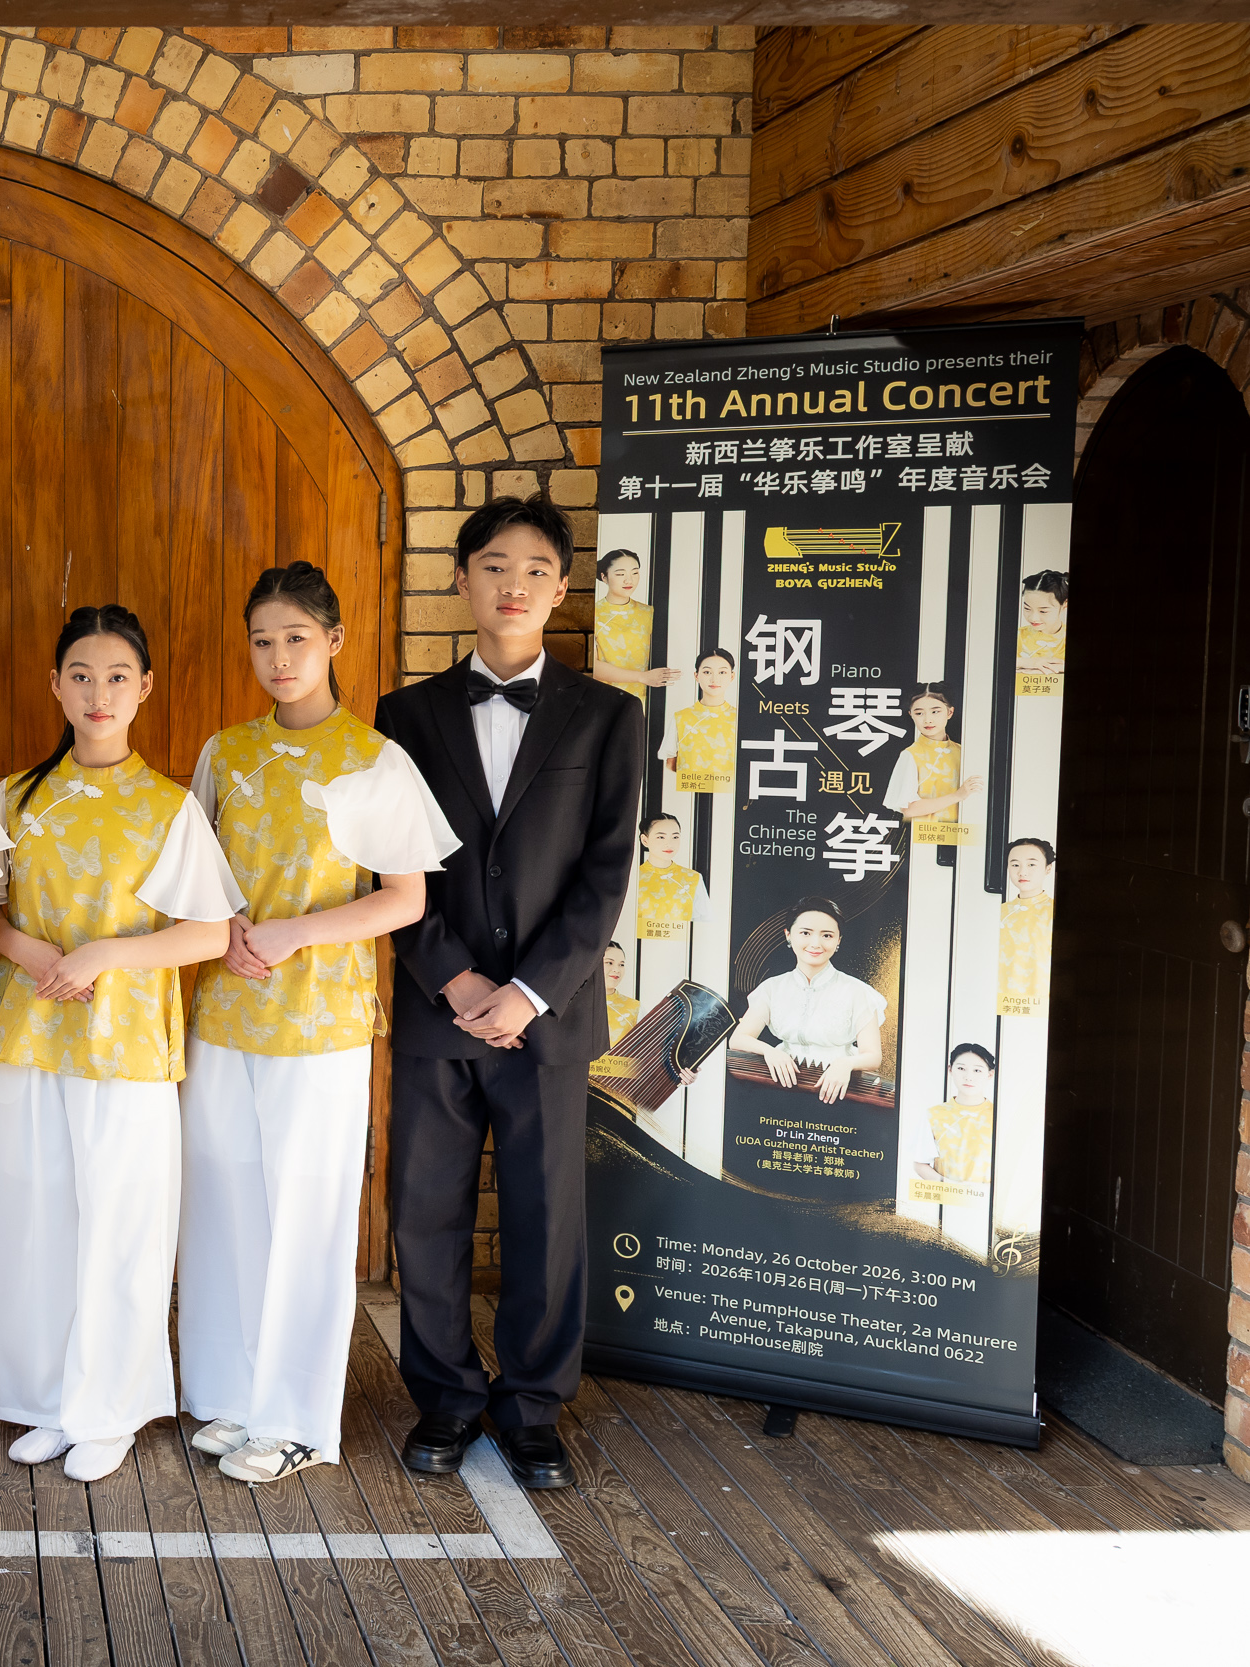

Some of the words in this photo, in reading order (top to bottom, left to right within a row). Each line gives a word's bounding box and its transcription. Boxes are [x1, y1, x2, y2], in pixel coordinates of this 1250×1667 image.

[624, 372, 659, 386] New
[664, 367, 732, 384] Zealand
[810, 359, 858, 377] Music
[863, 356, 920, 374] Studio
[926, 352, 1004, 374] presents
[1009, 349, 1052, 366] their
[625, 390, 706, 422] 11th
[720, 381, 868, 418] Annual
[882, 376, 1051, 412] Concert
[685, 430, 974, 466] 新西兰筝乐工作室呈献
[818, 563, 853, 572] Music
[856, 559, 896, 572] Studio
[775, 579, 812, 588] BOYA
[831, 664, 882, 678] Piano
[1022, 676, 1042, 684] Qiqi
[1044, 676, 1058, 684] Mo
[758, 700, 810, 716] Meets
[704, 774, 730, 782] Zheng
[818, 771, 873, 795] 遇见
[786, 810, 817, 824] The
[748, 824, 817, 840] Chinese
[918, 824, 938, 832] Ellie
[940, 826, 969, 834] Zheng
[739, 841, 816, 860] Guzheng
[646, 920, 670, 928] Grace
[672, 922, 684, 930] Lei
[1002, 996, 1030, 1005] Angel
[608, 1058, 628, 1068] Yong
[760, 1116, 803, 1129] Principal
[805, 1121, 858, 1134] Instructor:
[776, 1129, 788, 1138] Dr
[790, 1130, 804, 1140] Lin
[806, 1132, 840, 1145] Zheng
[735, 1135, 762, 1146] (UOA
[764, 1138, 808, 1152] Guzheng
[810, 1144, 837, 1154] Artist
[839, 1146, 884, 1161] Teacher)
[914, 1182, 964, 1194] Charmaine
[966, 1188, 984, 1198] Hua
[656, 1236, 697, 1252] Time:
[702, 1242, 767, 1264] Monday,
[772, 1252, 790, 1266] 26
[795, 1256, 858, 1274] October
[862, 1264, 906, 1284] 2026,
[910, 1270, 946, 1288] 3:00
[952, 1277, 976, 1292] PM
[654, 1285, 706, 1304] Venue:
[711, 1293, 738, 1308] The
[743, 1298, 836, 1324] PumpHouse
[840, 1312, 907, 1336] Theater,
[912, 1324, 932, 1338] 2a
[937, 1327, 1018, 1351] Manurere
[710, 1310, 772, 1332] Avenue,
[776, 1320, 859, 1346] Takapuna,
[864, 1334, 939, 1357] Auckland
[944, 1346, 984, 1364] 0622
